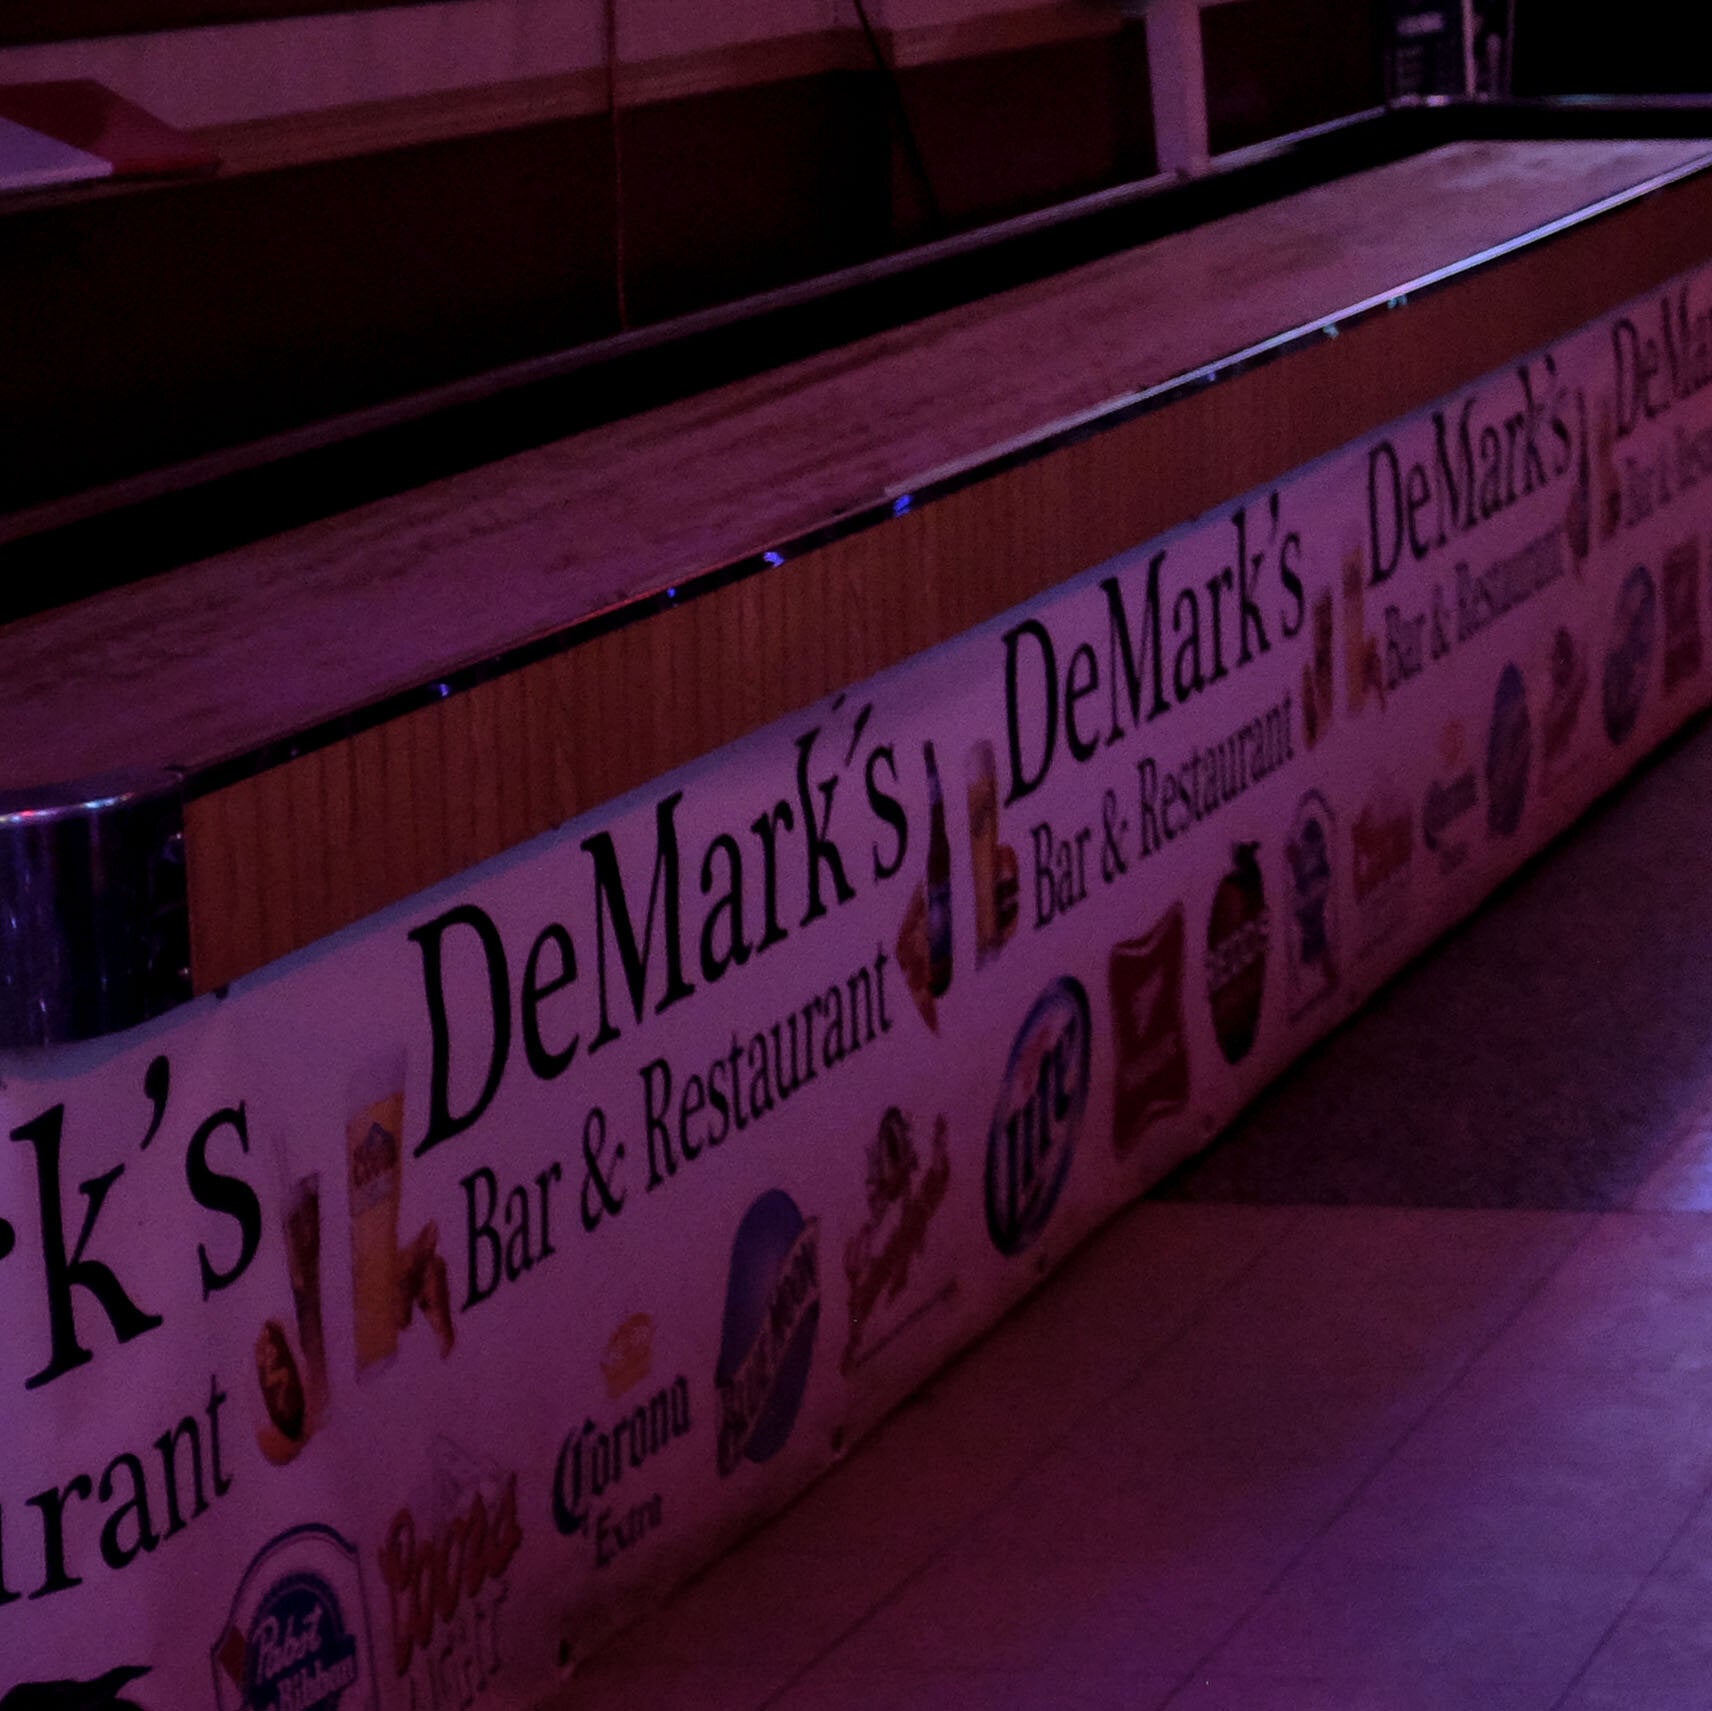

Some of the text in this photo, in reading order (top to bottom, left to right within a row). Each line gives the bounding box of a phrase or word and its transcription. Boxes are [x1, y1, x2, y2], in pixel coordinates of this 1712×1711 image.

[1368, 354, 1571, 586] DeMark's
[1002, 490, 1304, 808] DeMark's
[407, 692, 908, 1159] DeMark's
[1031, 694, 1293, 929] Bar & Restaurant
[0, 1055, 263, 1391] k's
[459, 942, 893, 1313] Bar & Restaurant
[553, 1375, 691, 1535] Corona
[594, 1492, 662, 1568] Extra
